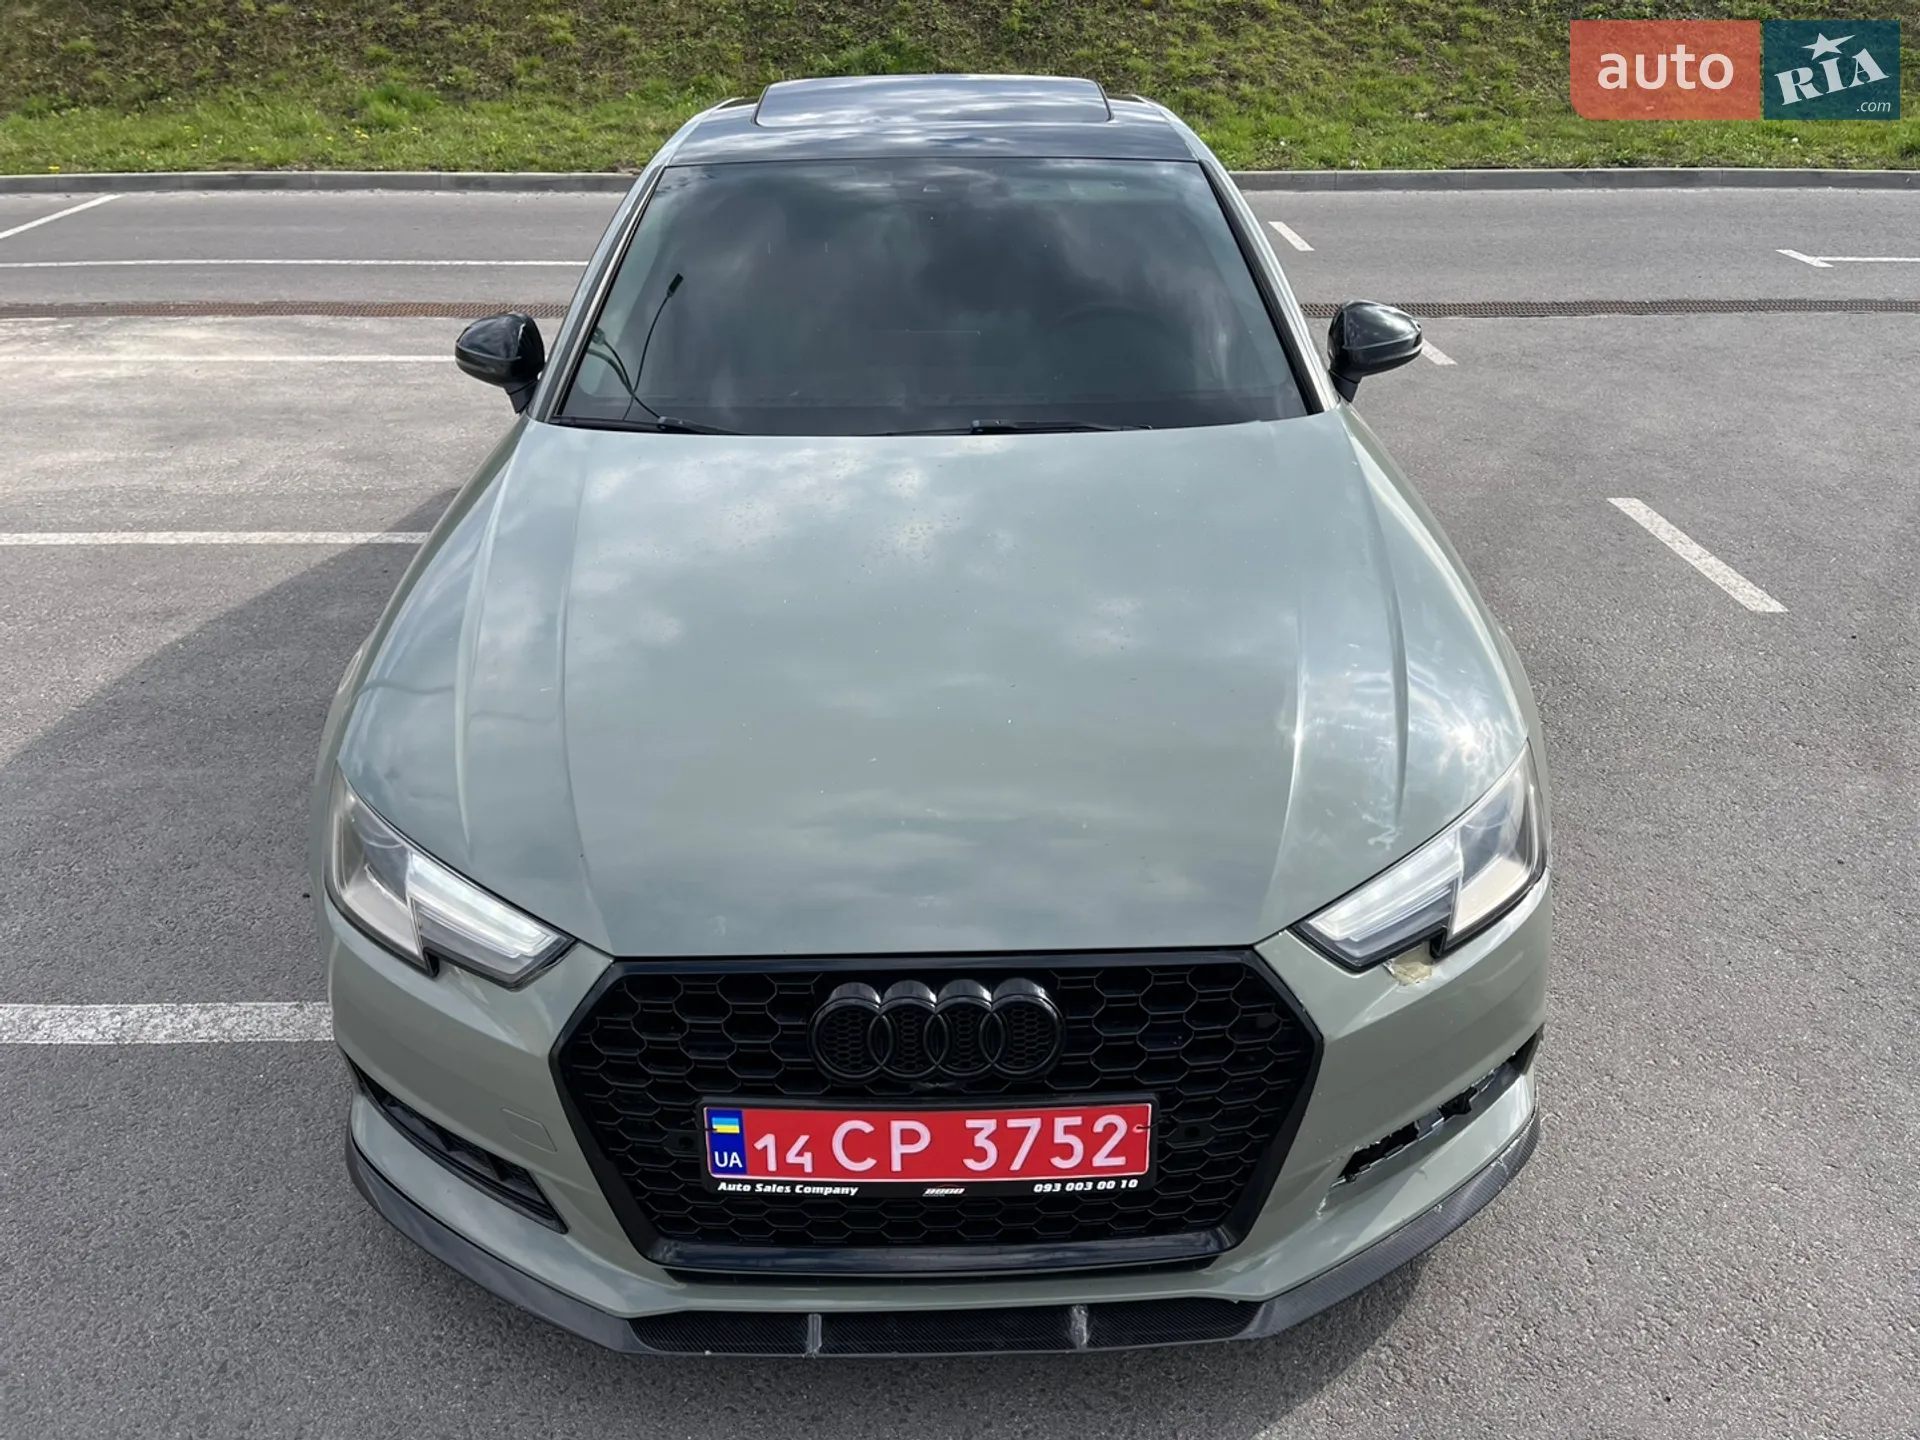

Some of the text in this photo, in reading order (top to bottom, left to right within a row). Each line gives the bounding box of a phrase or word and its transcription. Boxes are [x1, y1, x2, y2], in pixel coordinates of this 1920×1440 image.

[753, 1114, 1128, 1173] 14 CP 3752
[714, 1151, 743, 1168] UA
[717, 1181, 859, 1196] Auto Sales Company
[1033, 1179, 1139, 1192] 093 003 00 10
